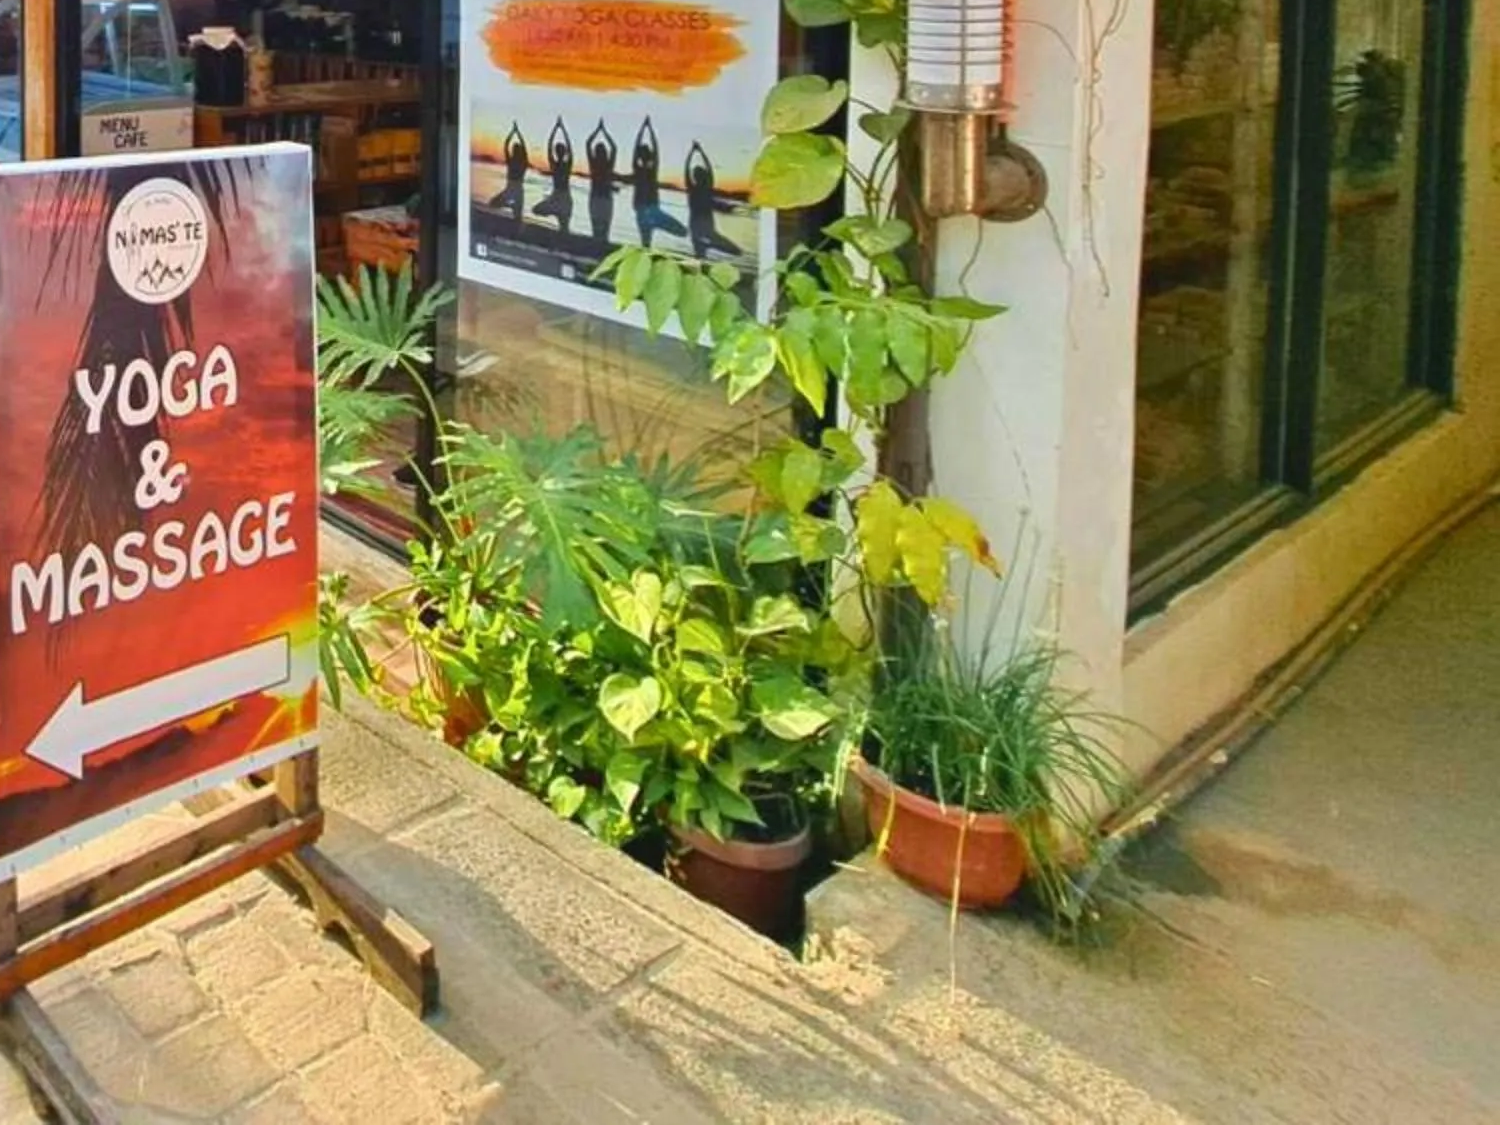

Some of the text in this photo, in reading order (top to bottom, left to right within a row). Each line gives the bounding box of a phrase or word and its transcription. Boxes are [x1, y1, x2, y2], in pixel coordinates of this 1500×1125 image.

[624, 9, 711, 30] CLASSES
[100, 117, 140, 133] MENU
[114, 131, 148, 149] CAFE
[76, 344, 237, 434] YOGA
[135, 440, 187, 510] &
[11, 491, 297, 635] MASSAGE
